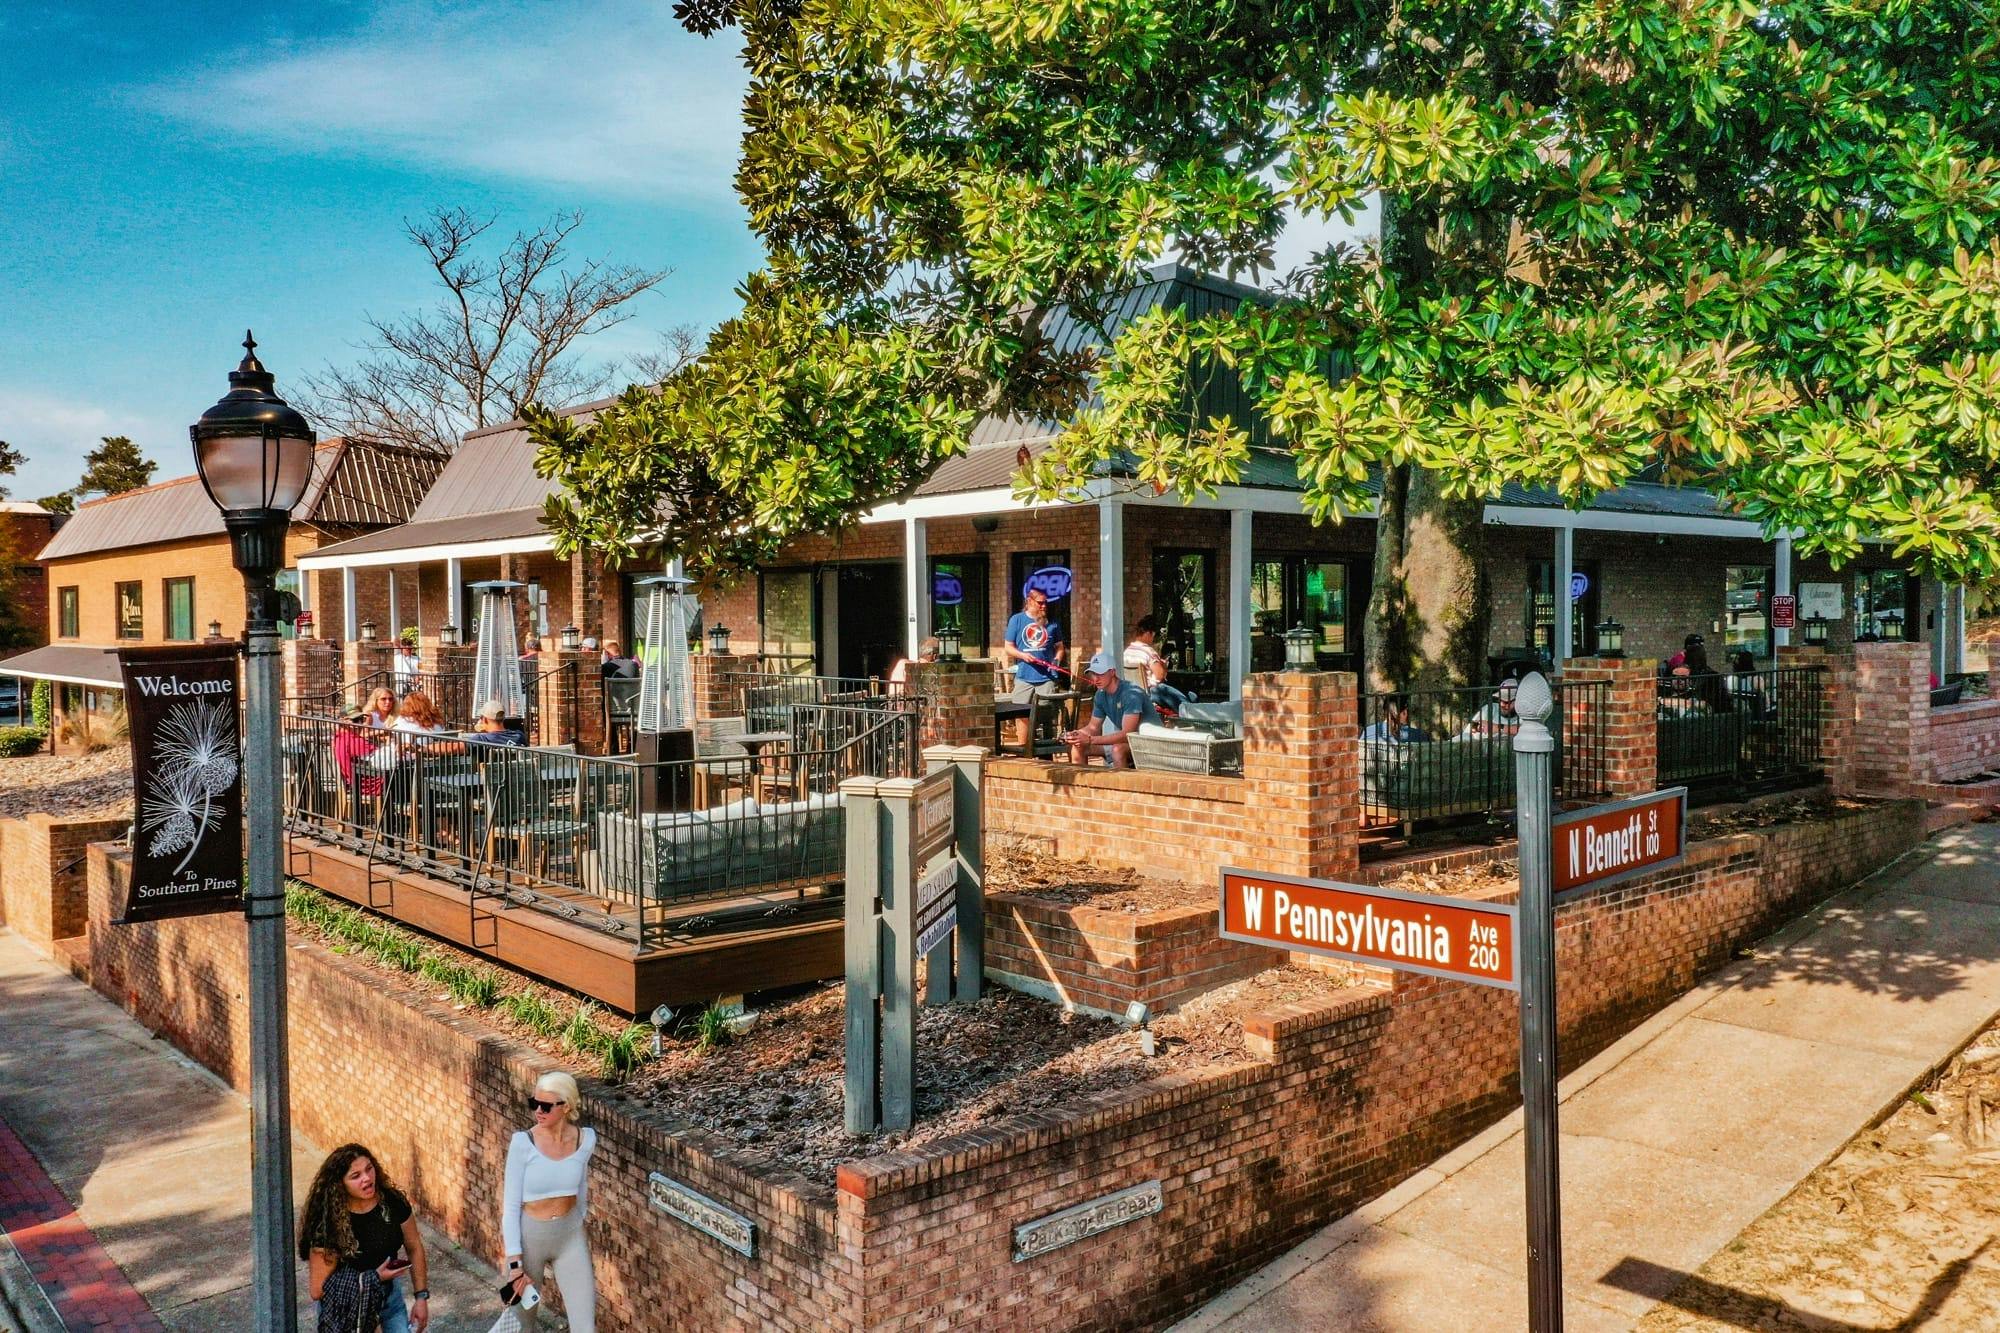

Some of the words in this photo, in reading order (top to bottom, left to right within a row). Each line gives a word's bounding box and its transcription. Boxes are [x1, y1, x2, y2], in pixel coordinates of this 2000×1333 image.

[1774, 597, 1793, 605] STOP
[134, 675, 233, 697] Welcome
[1569, 828, 1580, 879] N
[1585, 813, 1642, 874] Bennett
[1648, 809, 1658, 832] St
[1646, 832, 1660, 857] 100
[138, 881, 200, 898] Southern
[203, 878, 238, 891] Pines
[184, 870, 198, 881] To
[920, 914, 957, 955] Rehabilitation
[1242, 885, 1264, 931] W
[1274, 889, 1451, 964] Pennsylvania
[1469, 918, 1499, 946] Ave
[1469, 944, 1500, 972] 200
